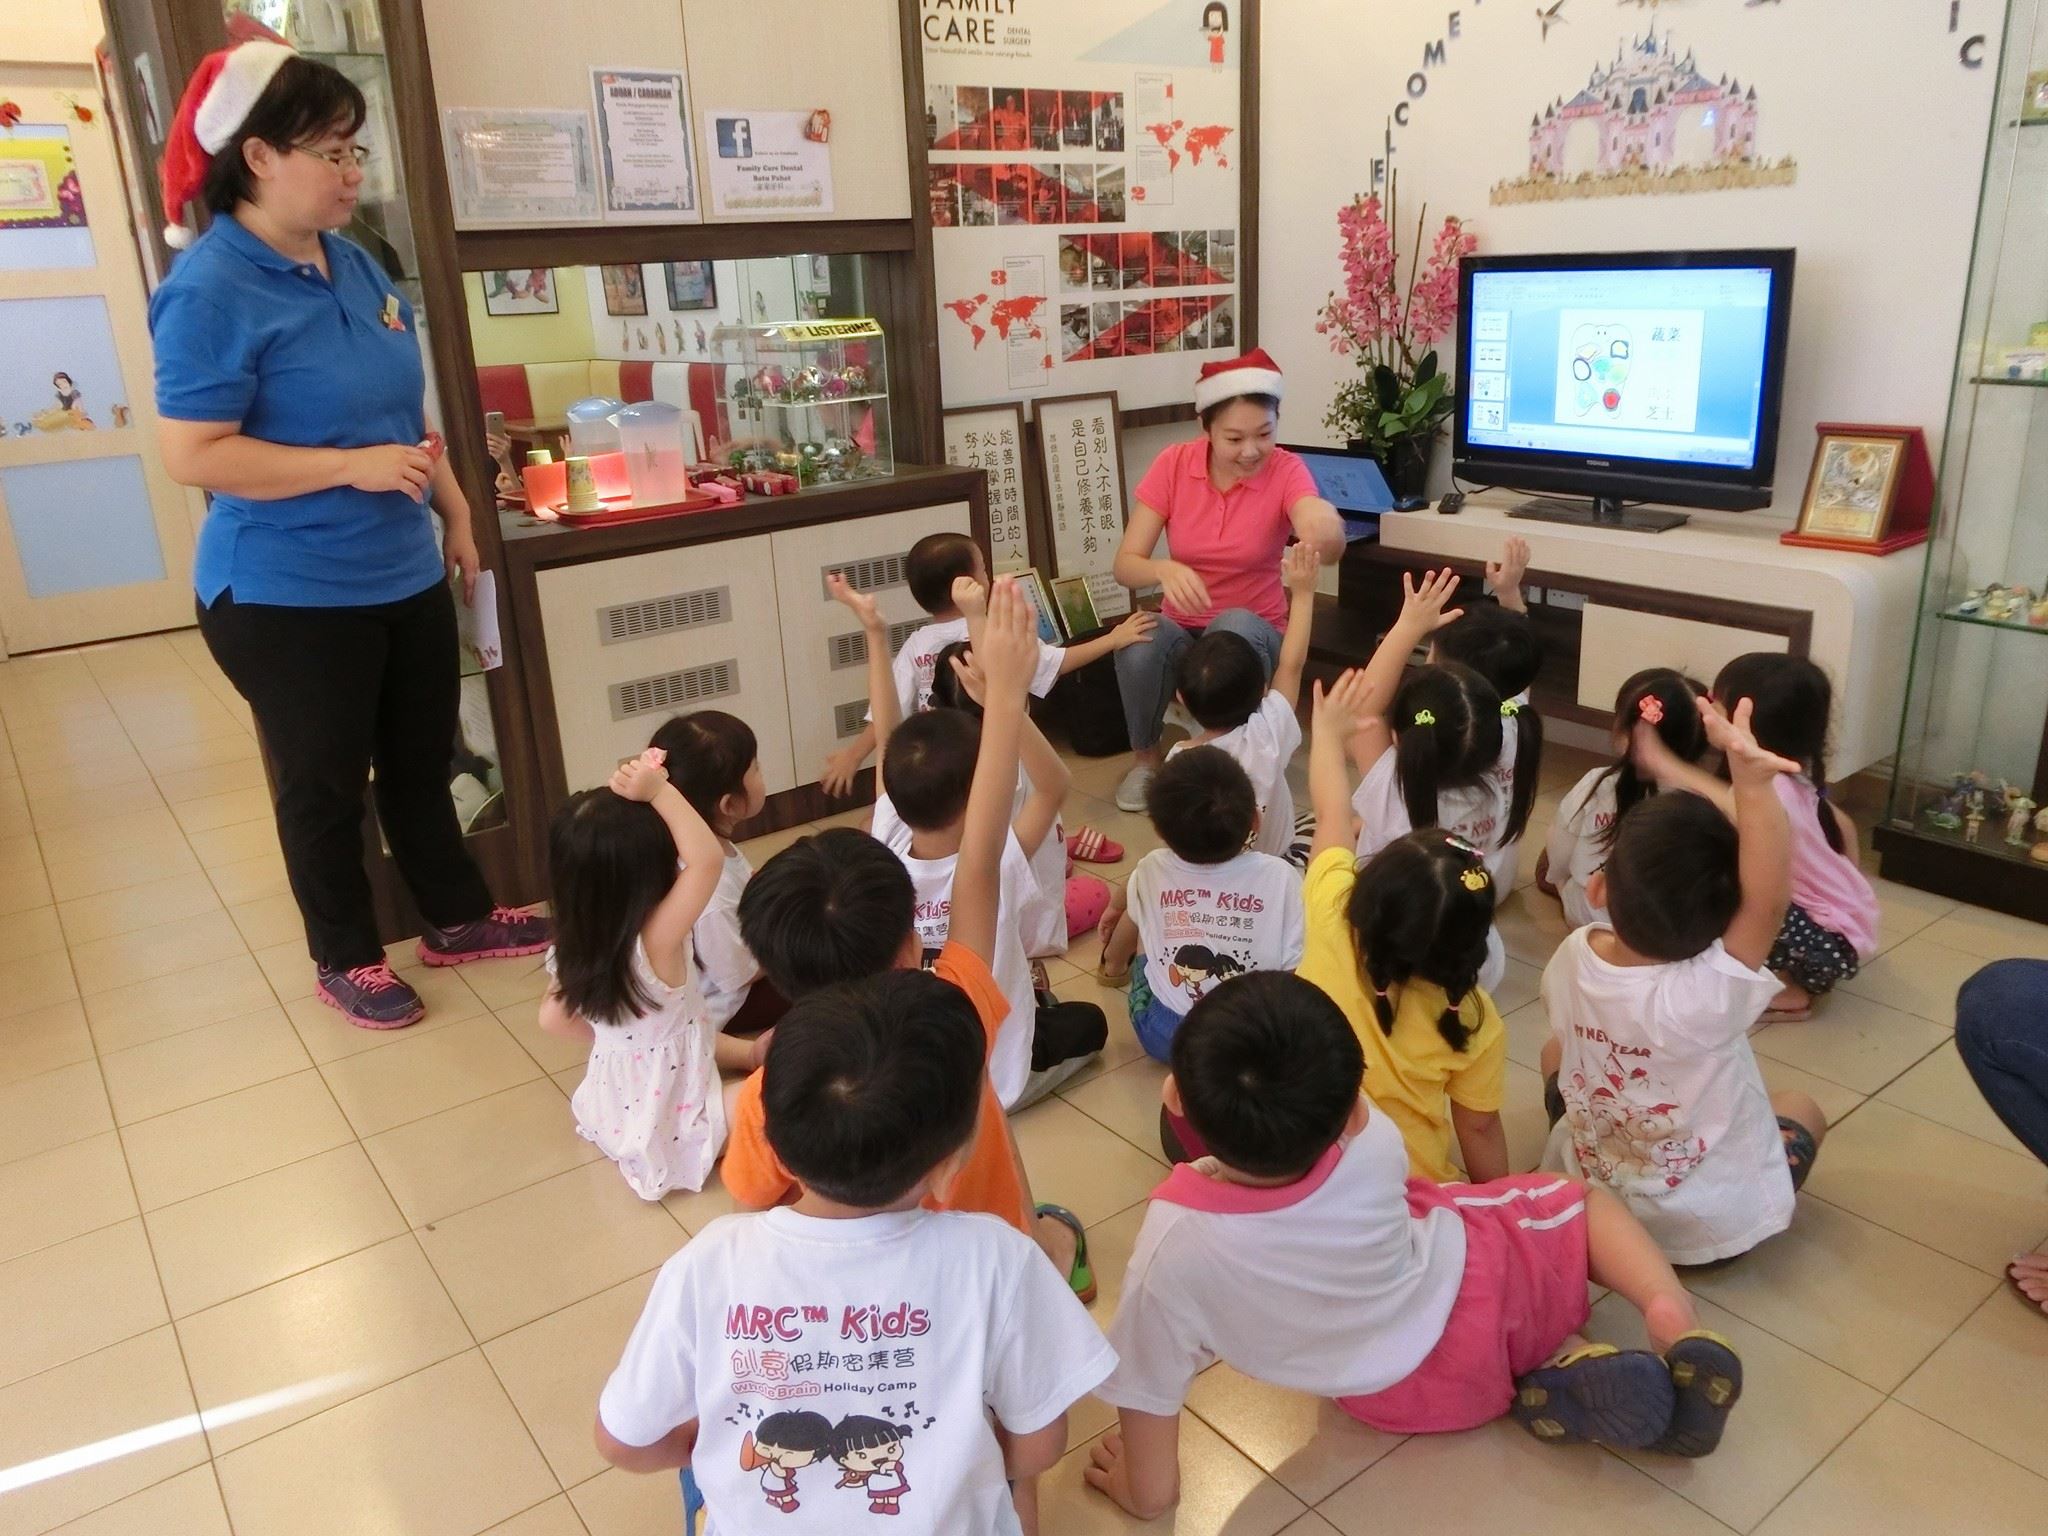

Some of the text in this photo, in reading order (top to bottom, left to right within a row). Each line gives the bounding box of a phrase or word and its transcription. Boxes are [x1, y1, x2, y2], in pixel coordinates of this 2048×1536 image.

[923, 14, 995, 44] CARE
[1007, 26, 1031, 36] DENTAL
[1003, 37, 1031, 46] SURGERY
[806, 321, 878, 337] LISTERINE
[915, 899, 951, 921] Kids
[1216, 891, 1265, 913] Kids
[1232, 935, 1253, 943] Camp
[1610, 1040, 1652, 1058] YEAR
[840, 1301, 931, 1343] Kids
[730, 1346, 916, 1382] 创意假期密集营
[734, 1381, 918, 1398] Whole Brain Holiday Camp
